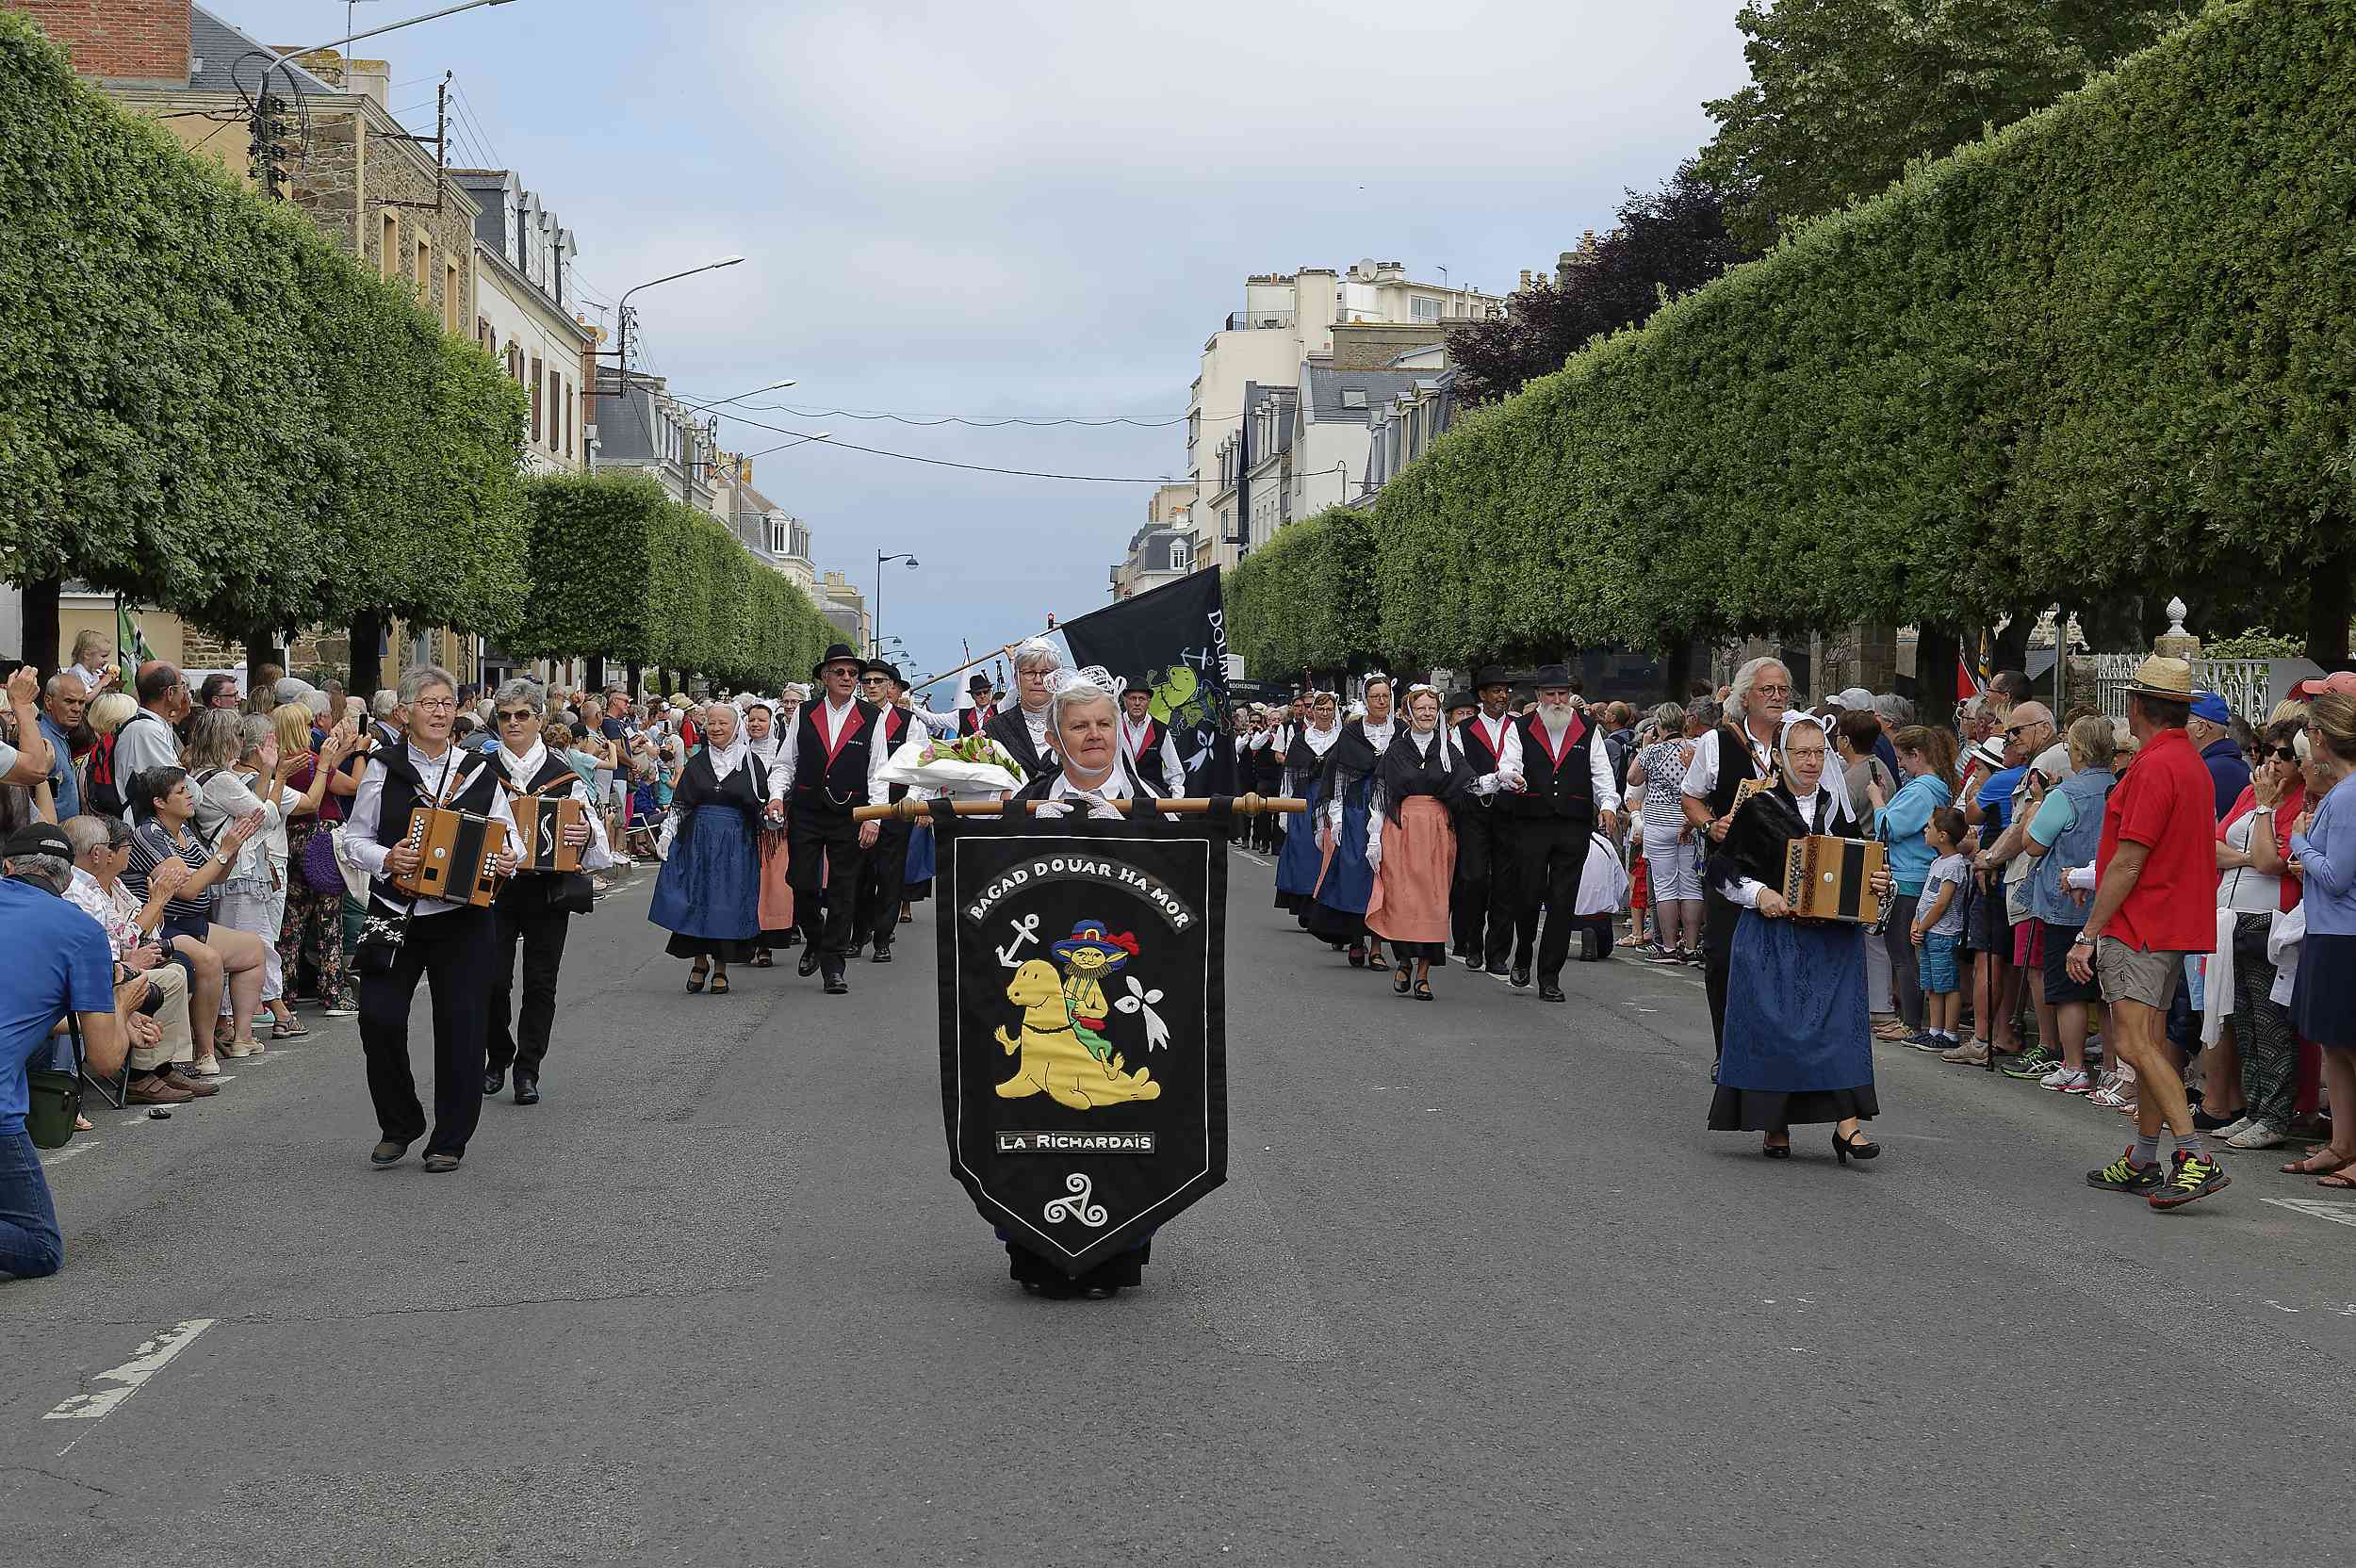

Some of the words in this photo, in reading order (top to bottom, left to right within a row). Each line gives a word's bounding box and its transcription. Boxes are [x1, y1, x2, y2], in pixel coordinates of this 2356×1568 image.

[970, 869, 1029, 920] BAGAD
[1034, 858, 1112, 877] DOUAR
[1118, 867, 1147, 891] HA
[1150, 888, 1190, 927] MOR
[1000, 1136, 1026, 1150] LA
